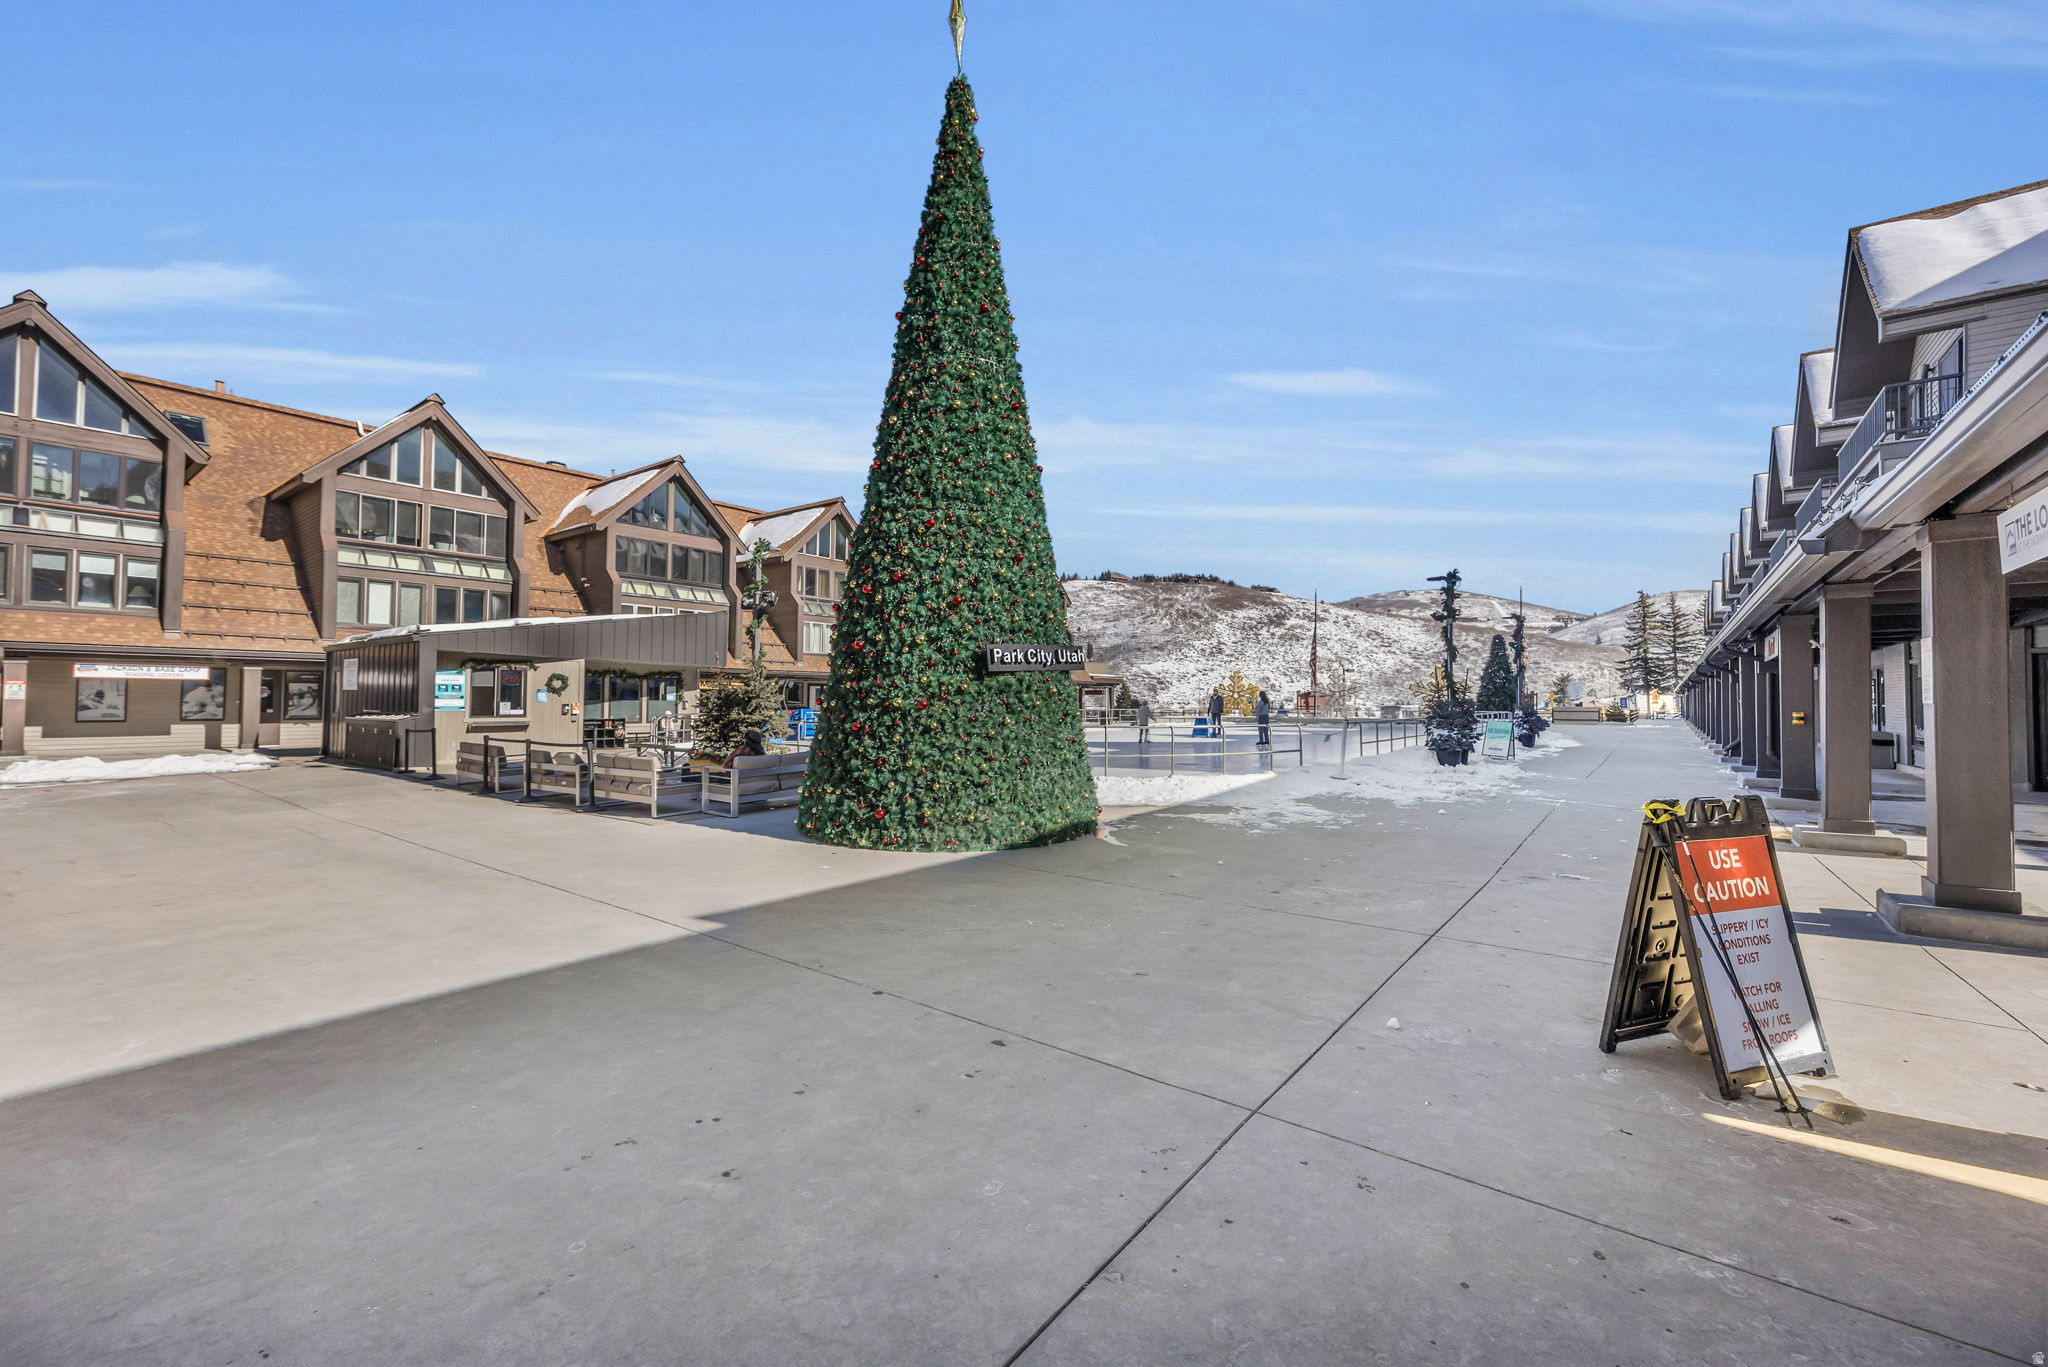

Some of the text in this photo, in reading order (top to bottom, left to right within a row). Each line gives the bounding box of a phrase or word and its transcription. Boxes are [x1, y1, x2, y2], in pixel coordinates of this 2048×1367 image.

[2015, 511, 2032, 541] THE
[993, 648, 1085, 666] Park City, Utah
[1708, 848, 1742, 870] USE
[1693, 876, 1770, 903] CAUTION
[1711, 921, 1748, 935] SIPPERY
[1756, 918, 1769, 930] ICY
[1736, 952, 1760, 965] EXIST
[1764, 981, 1782, 994] FOR
[1748, 999, 1779, 1014] ALLING
[1776, 1014, 1791, 1026] ICE
[1742, 1029, 1798, 1051] FRO ROOFS
